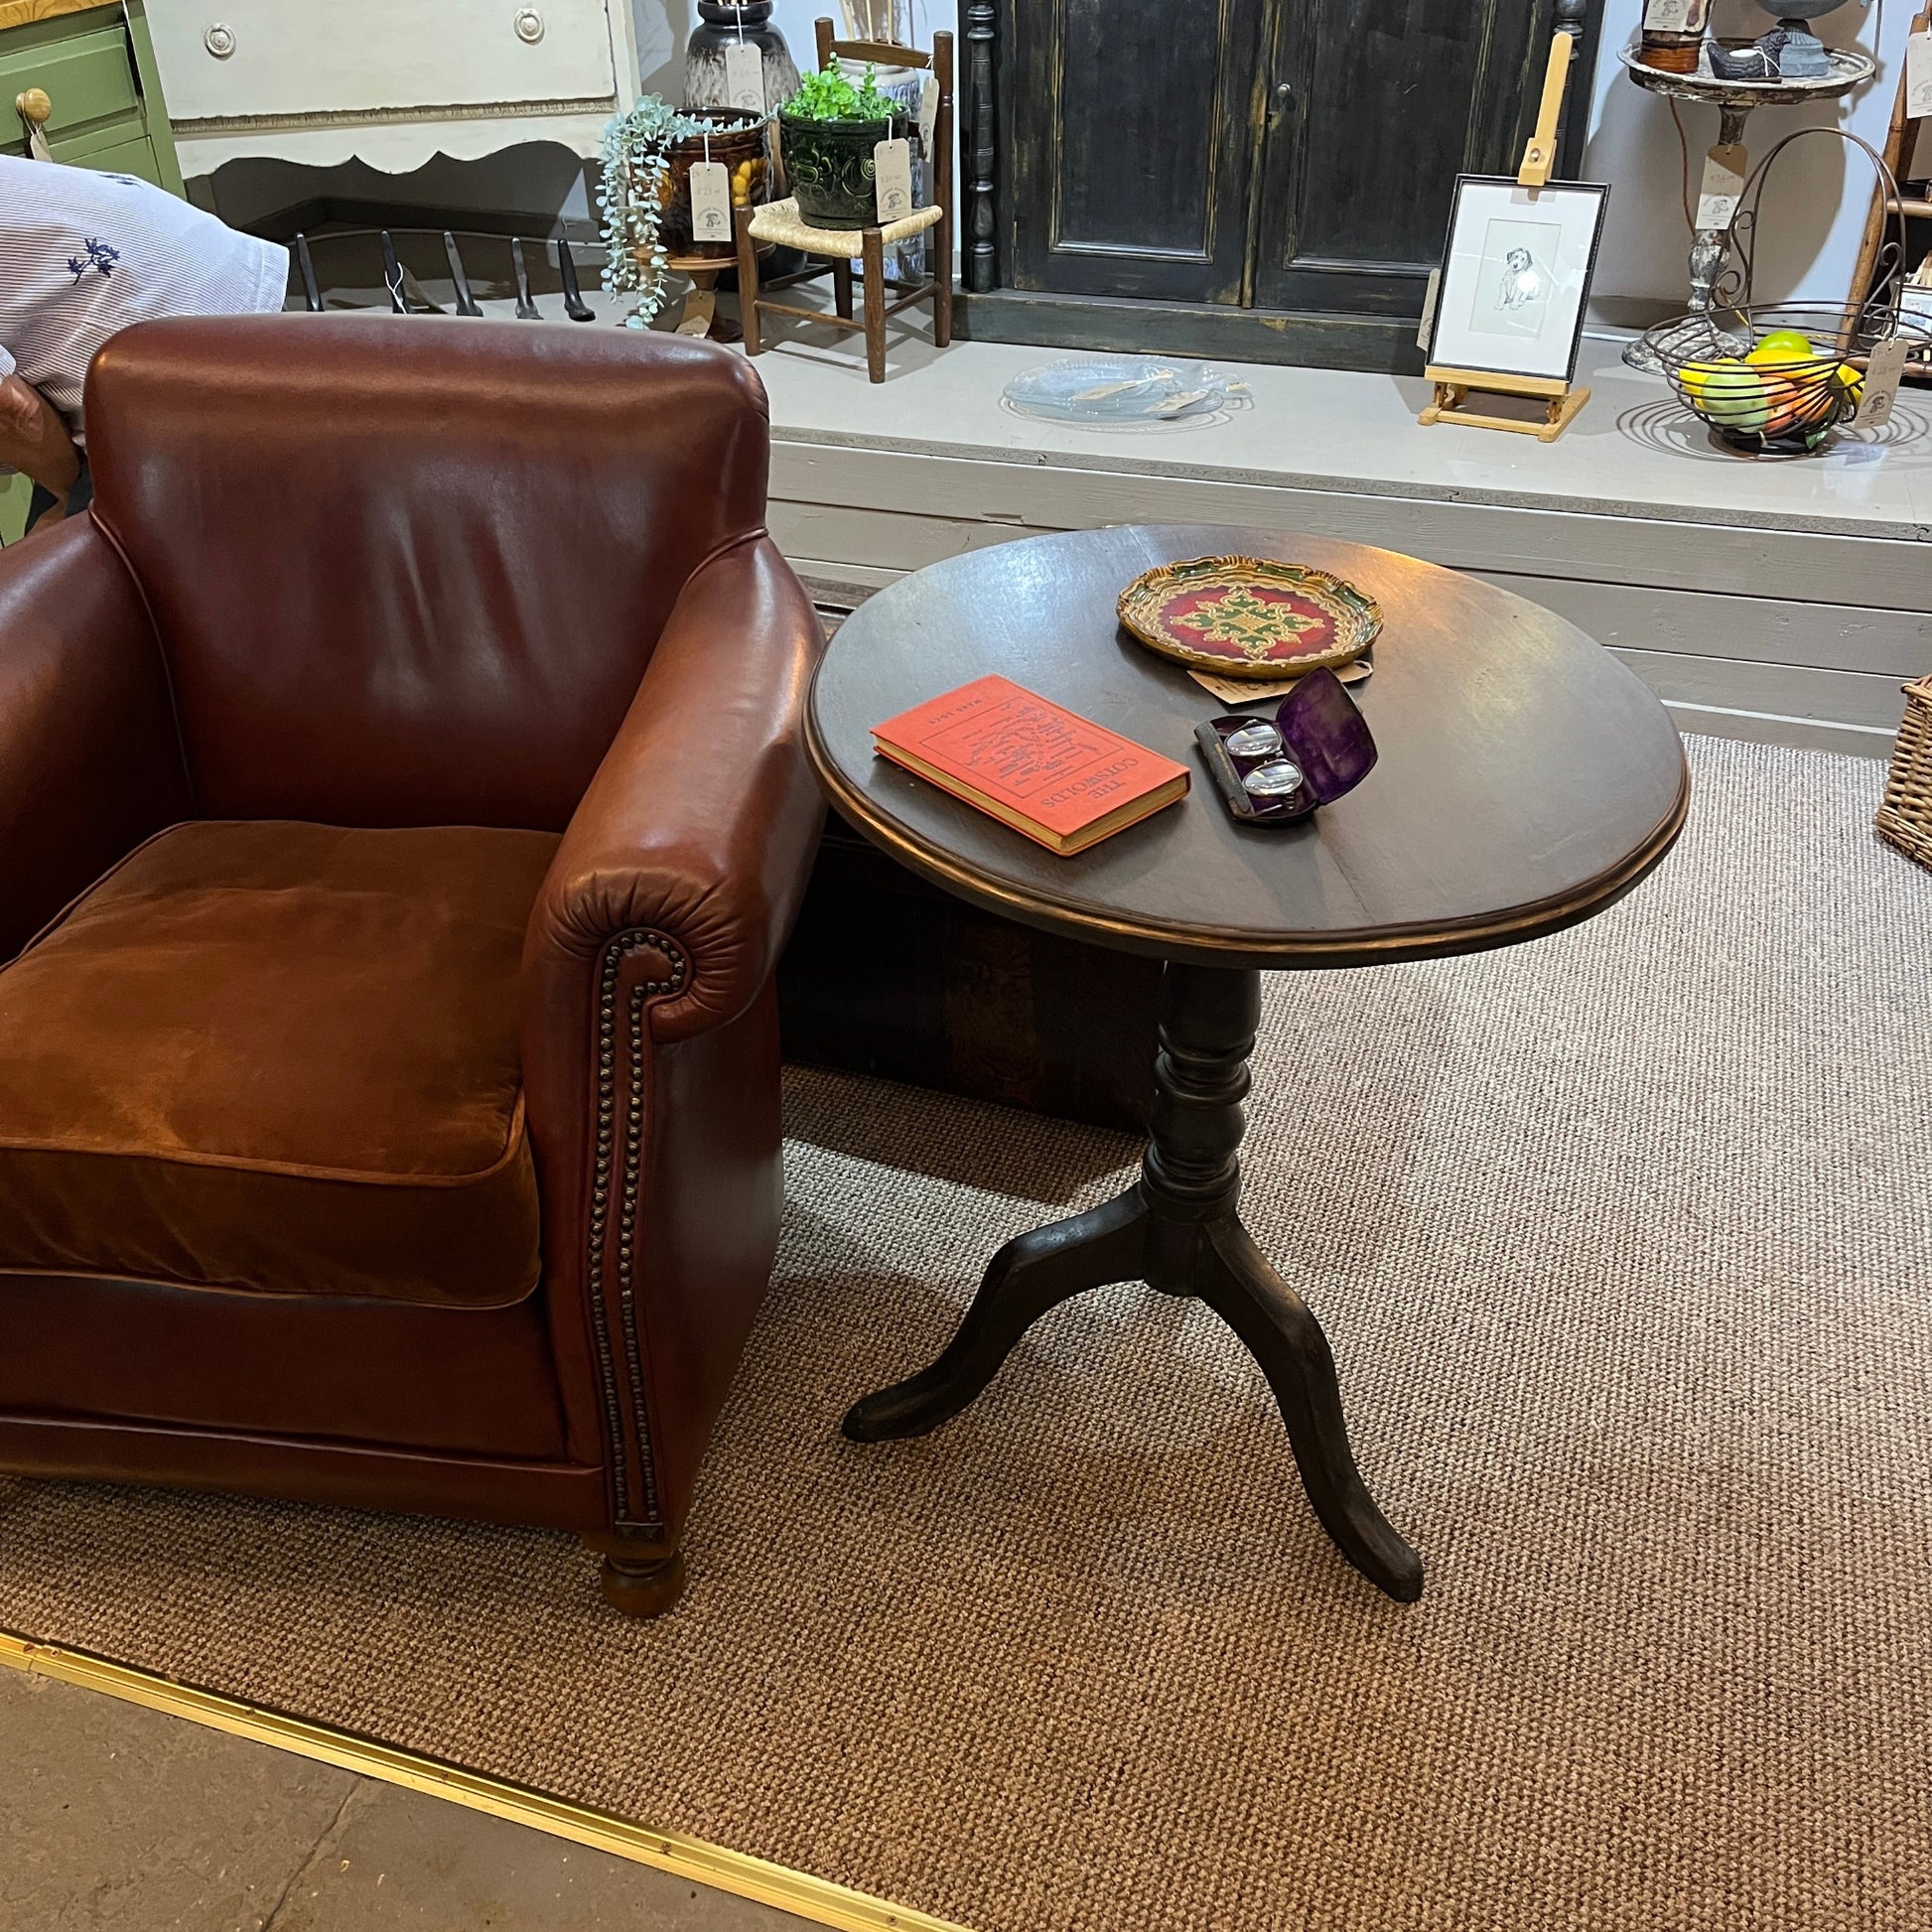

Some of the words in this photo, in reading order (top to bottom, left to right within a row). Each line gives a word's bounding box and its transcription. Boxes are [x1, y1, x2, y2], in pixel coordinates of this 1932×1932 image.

[955, 699, 983, 713] WARD
[1040, 757, 1140, 808] COTSWOLDS
[1086, 779, 1127, 799] THE
